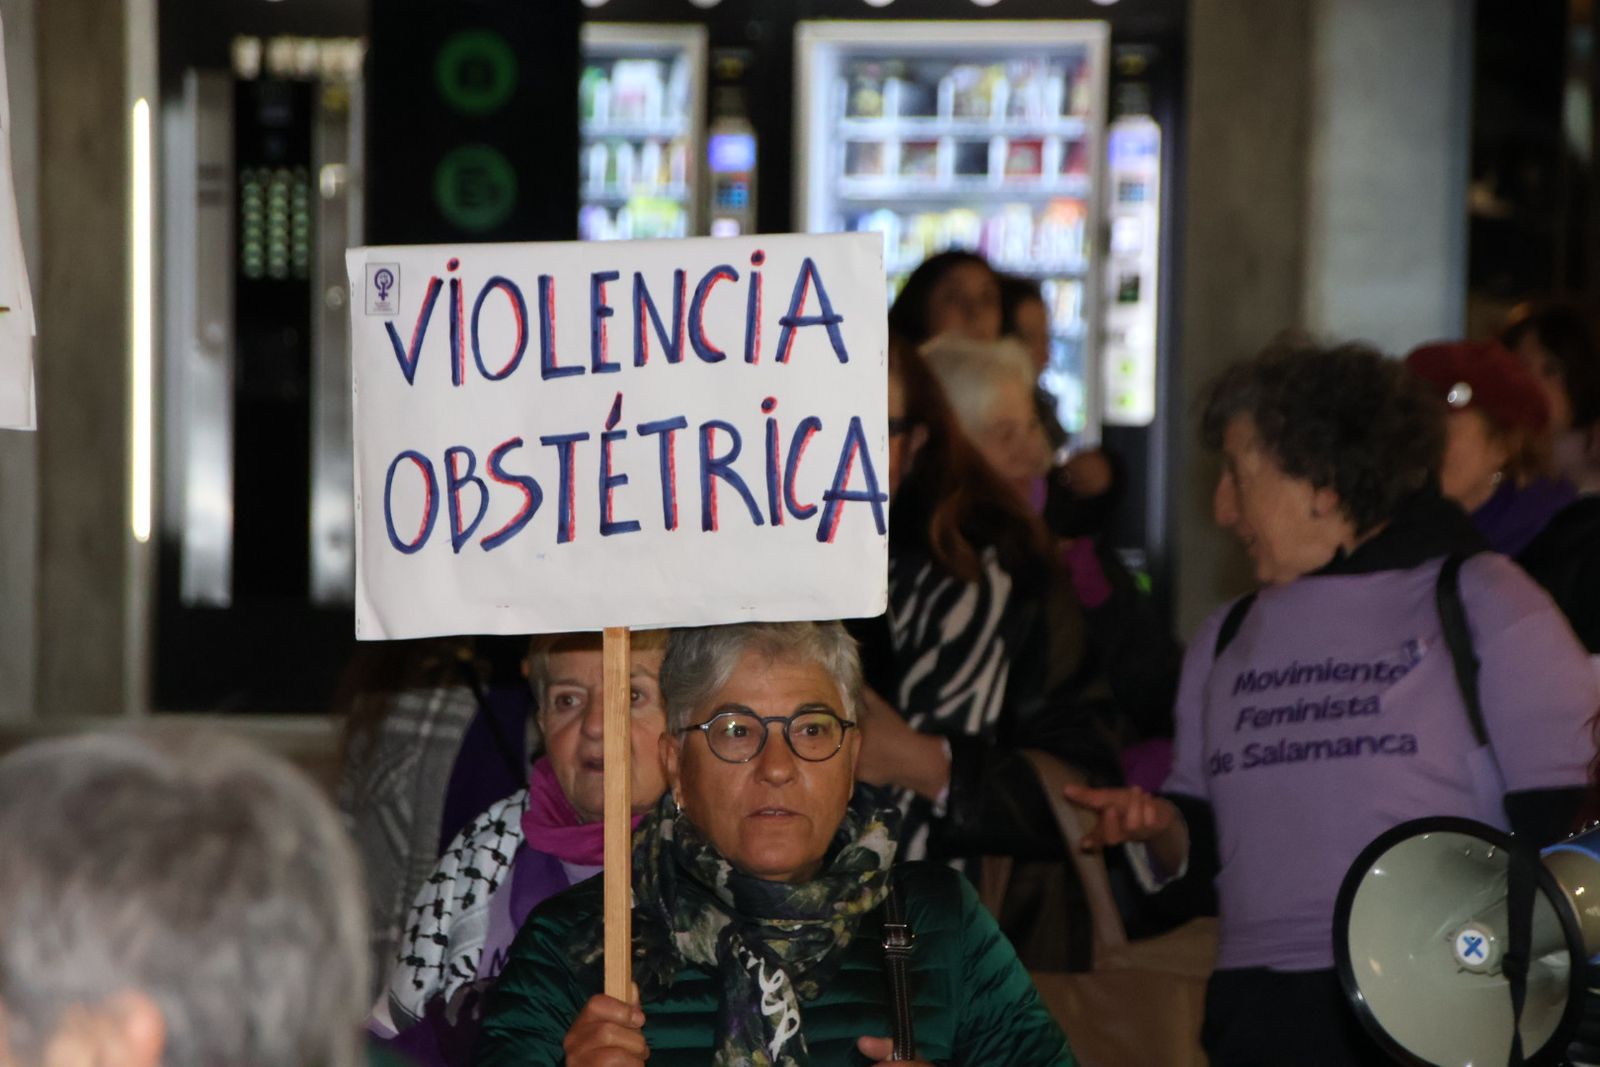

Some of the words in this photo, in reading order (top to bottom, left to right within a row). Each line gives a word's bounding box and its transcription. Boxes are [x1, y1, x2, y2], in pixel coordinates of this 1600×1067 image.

[1232, 657, 1411, 696] Movimiento
[1235, 695, 1381, 731] Feminista
[1209, 748, 1235, 776] de
[1241, 734, 1419, 769] Salamanca
